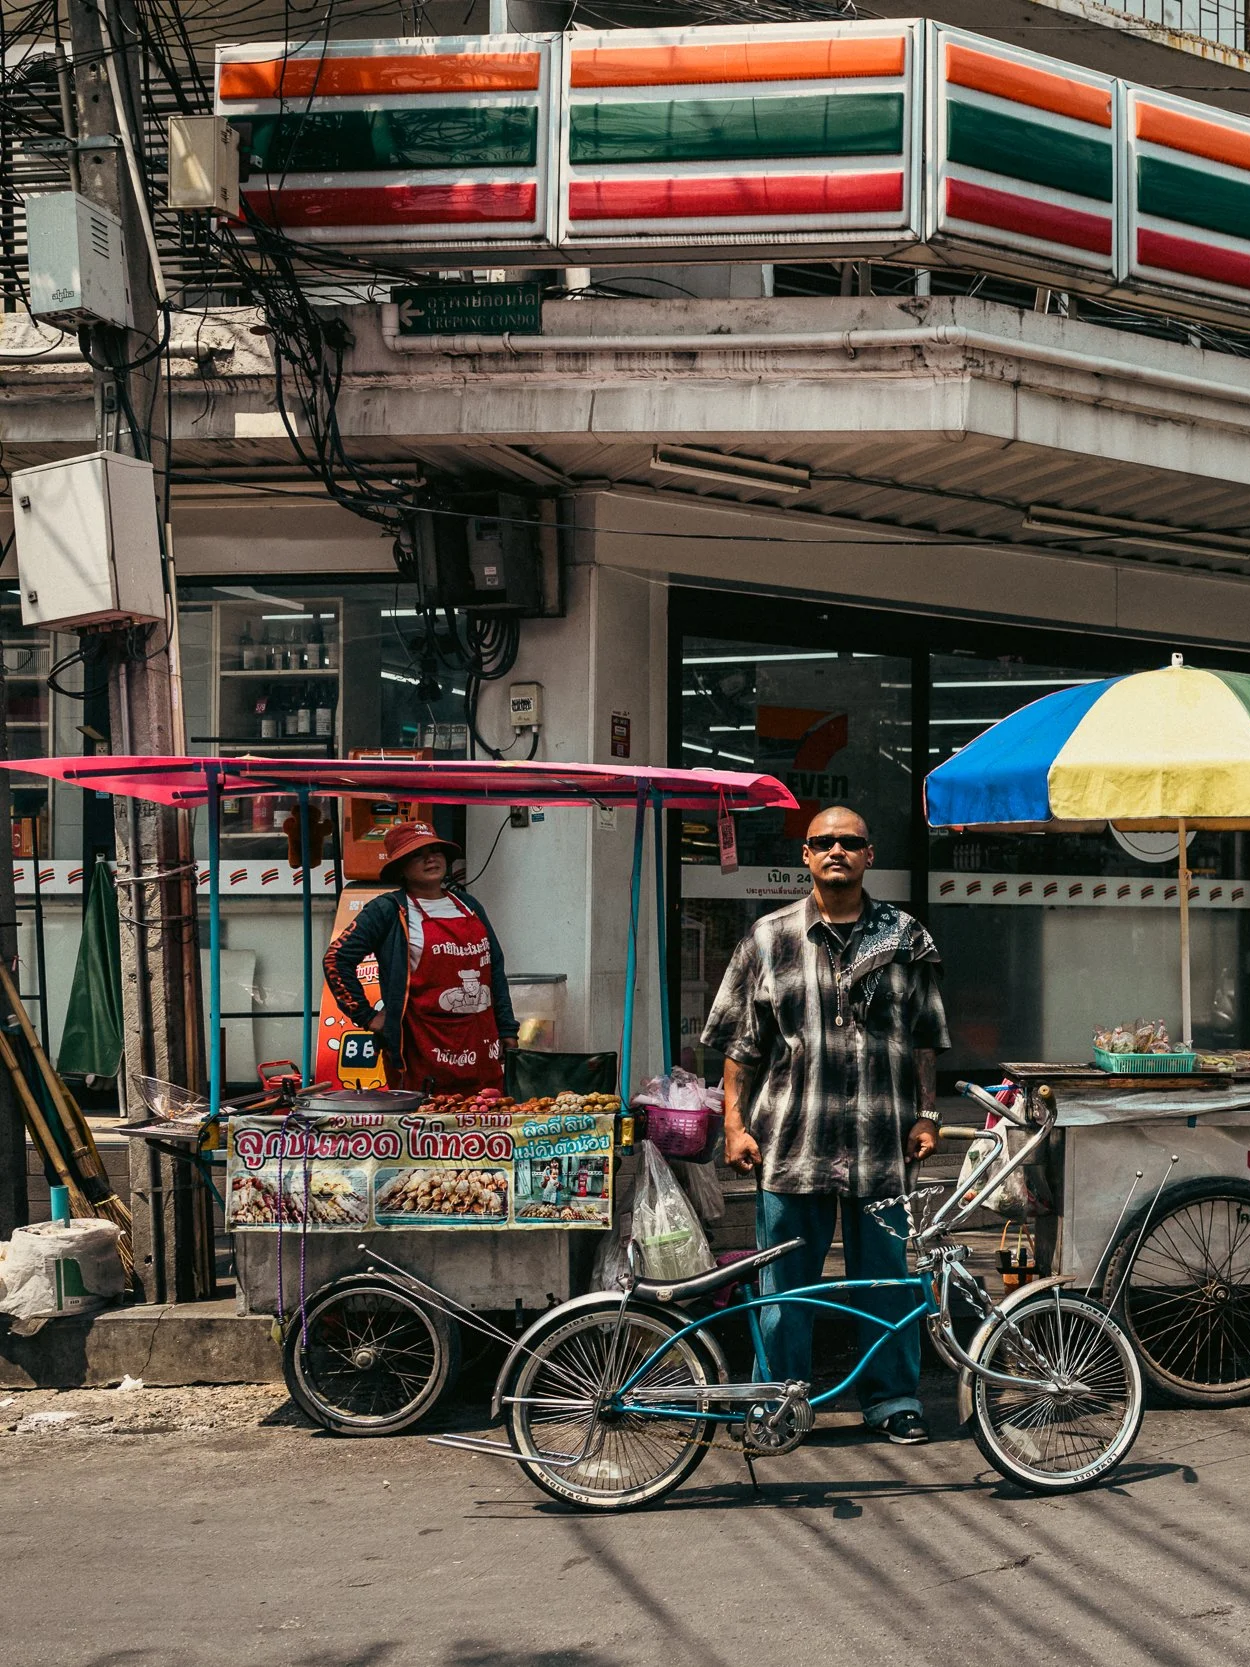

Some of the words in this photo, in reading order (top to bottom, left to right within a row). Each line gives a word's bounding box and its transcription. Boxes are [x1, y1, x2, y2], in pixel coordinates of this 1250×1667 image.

[51, 288, 75, 303] alpha
[491, 314, 535, 327] CONDO
[767, 869, 791, 883] เปิด
[796, 873, 812, 884] 24
[350, 1113, 384, 1127] บาท
[456, 1114, 476, 1127] 15
[480, 1114, 512, 1127] บาท
[400, 1115, 514, 1162] ไก่ทอด
[513, 1135, 611, 1160] แม่ค้าตัวน้อย
